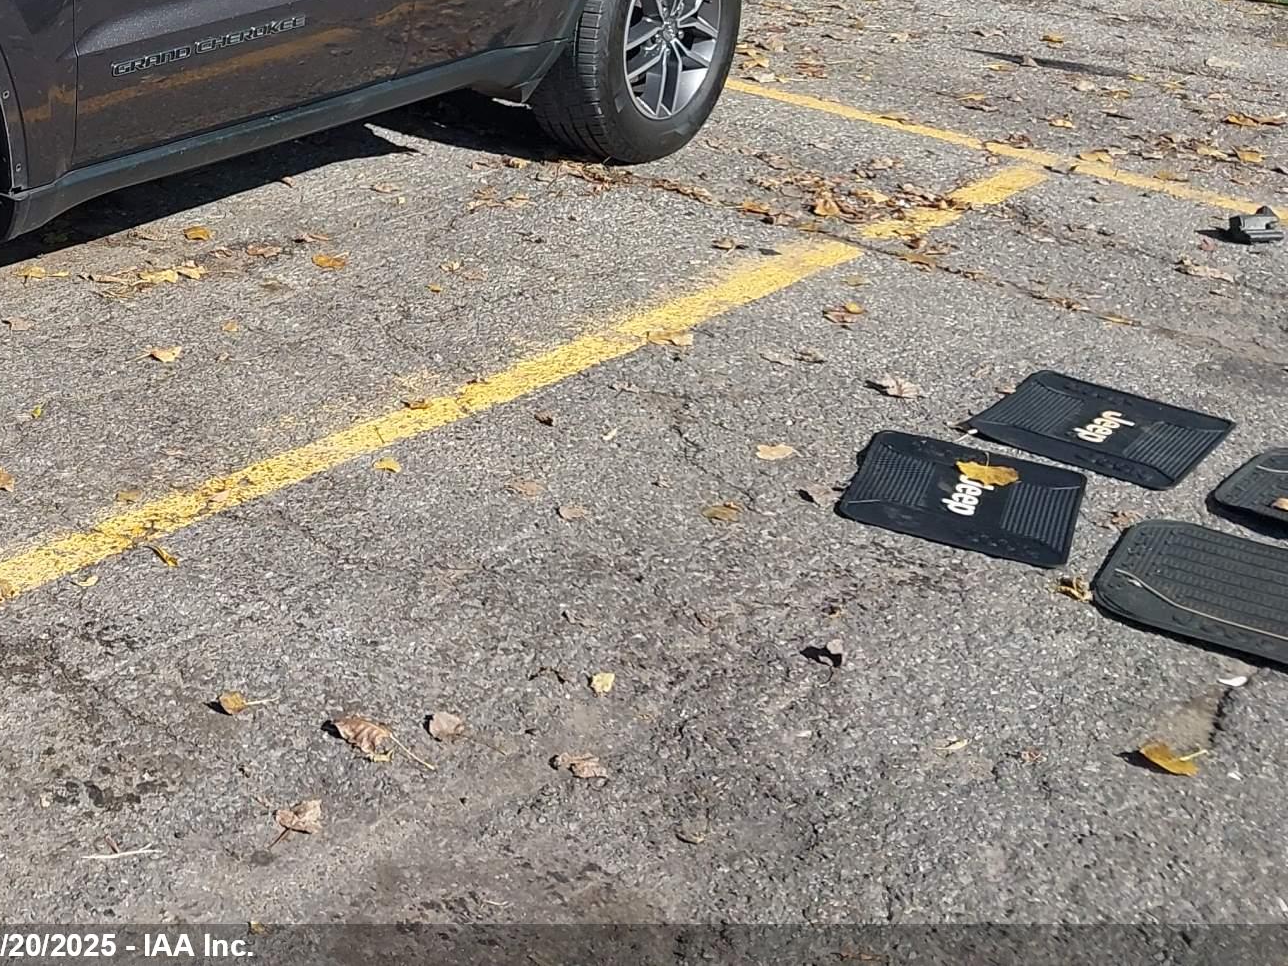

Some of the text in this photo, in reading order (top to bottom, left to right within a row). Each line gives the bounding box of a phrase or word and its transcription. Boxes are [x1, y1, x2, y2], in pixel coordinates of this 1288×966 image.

[112, 14, 306, 76] GRAND CHEROKEE
[1073, 410, 1136, 443] Jeep
